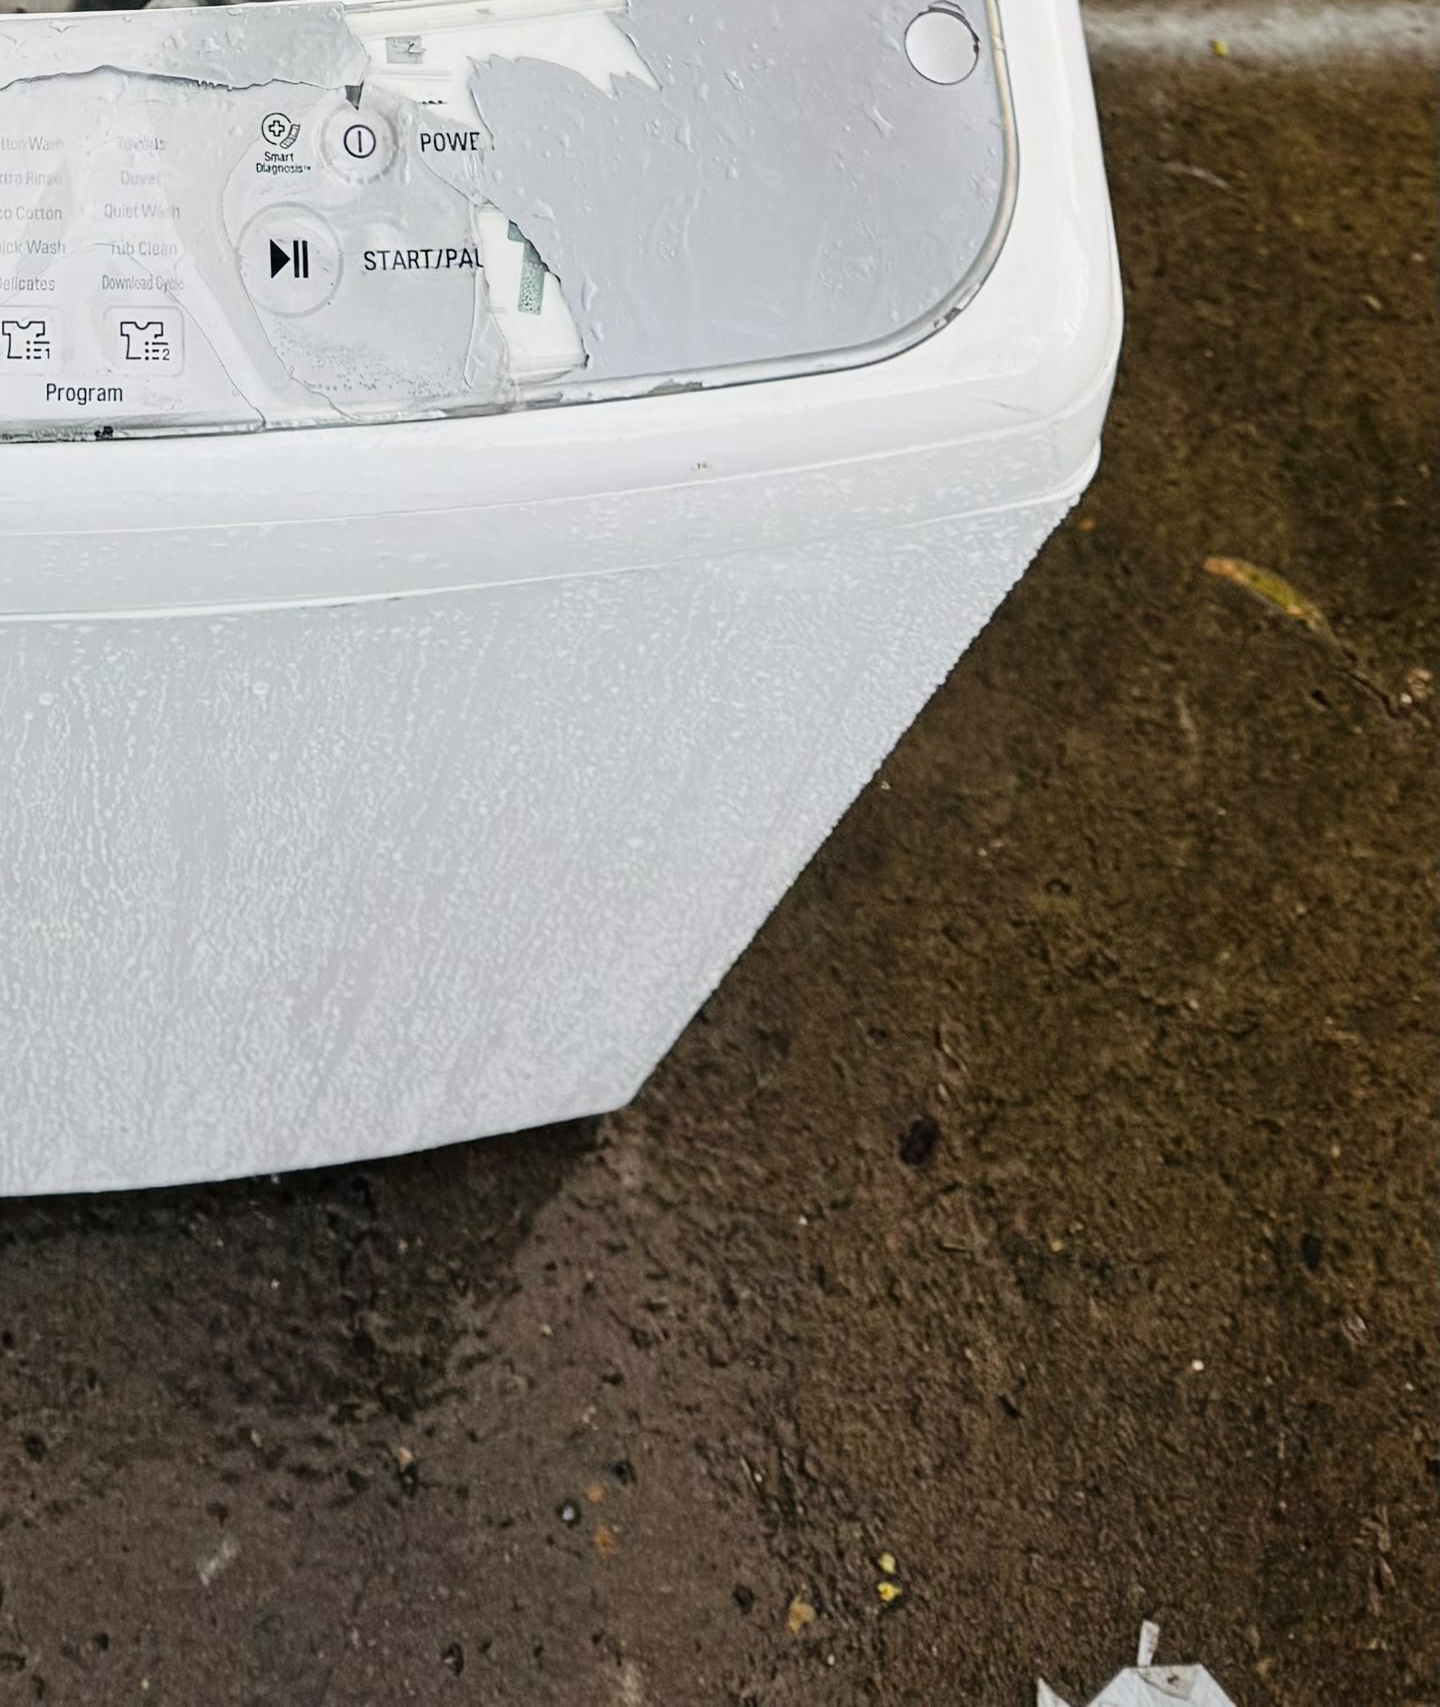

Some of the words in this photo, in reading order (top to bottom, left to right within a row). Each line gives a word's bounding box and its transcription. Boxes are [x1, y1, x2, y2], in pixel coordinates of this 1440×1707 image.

[420, 131, 494, 152] POWE
[264, 152, 294, 163] Smart
[16, 206, 63, 221] Cotton
[141, 204, 180, 219] Wh
[26, 239, 66, 255] Wash
[102, 274, 153, 290] Download
[46, 384, 123, 403] Program
